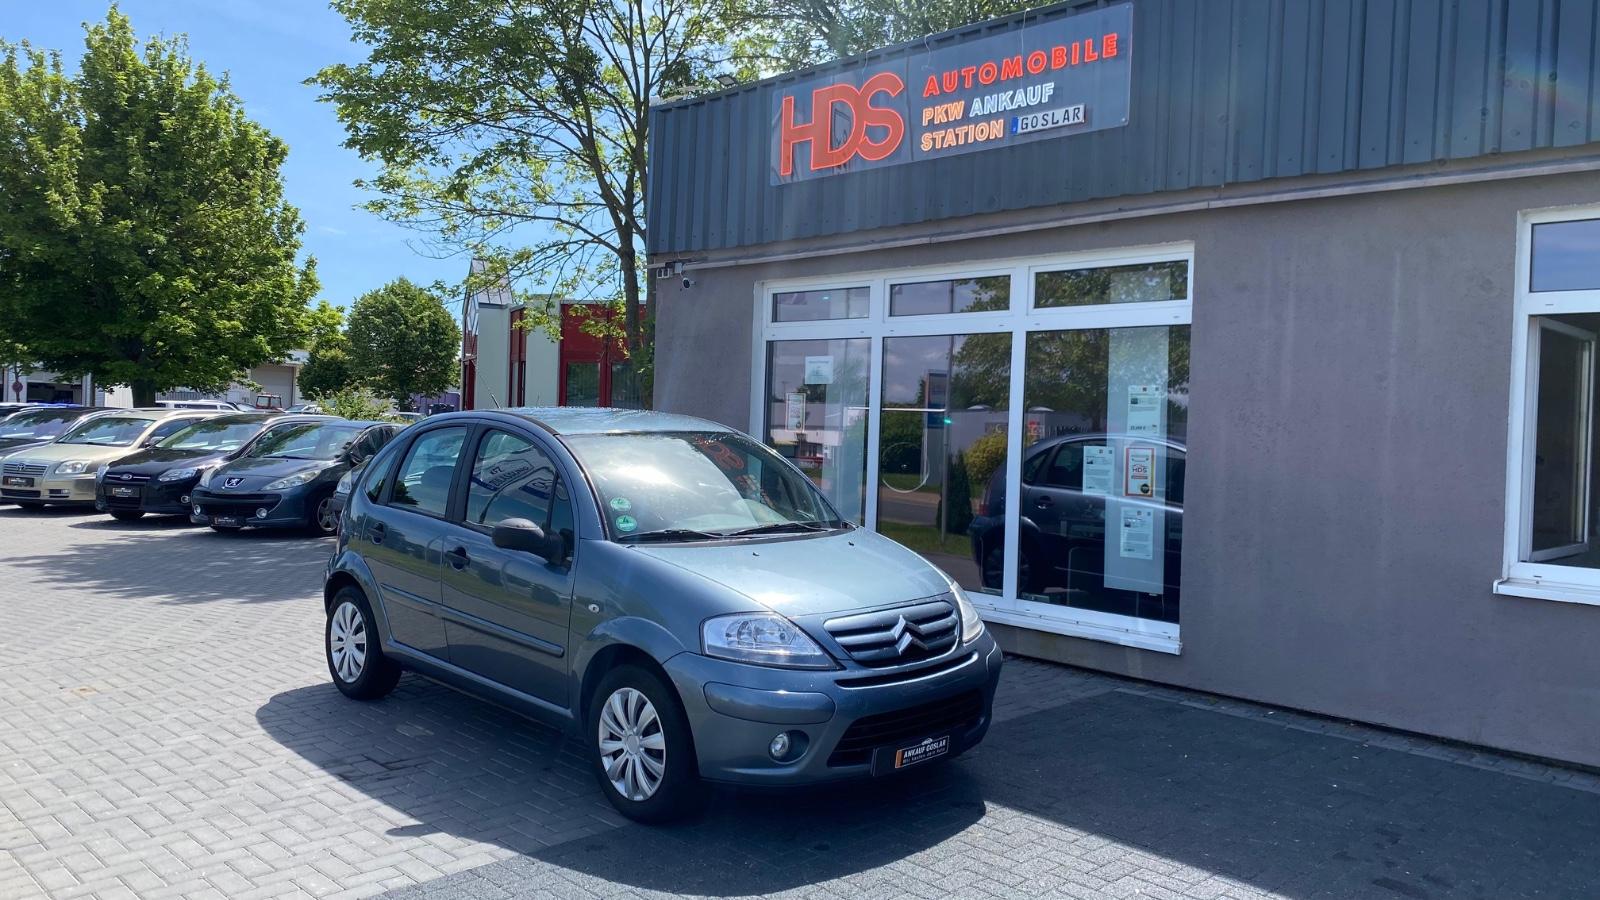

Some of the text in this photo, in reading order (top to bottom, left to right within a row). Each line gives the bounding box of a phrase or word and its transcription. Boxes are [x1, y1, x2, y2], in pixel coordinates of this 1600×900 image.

[922, 32, 1119, 98] AUTOMOBILE
[780, 71, 905, 176] HDS
[921, 81, 1055, 127] PKW ANKAUF
[920, 107, 1082, 152] STATION GOSLAR
[904, 739, 946, 758] ANKAUF GOSLAR
